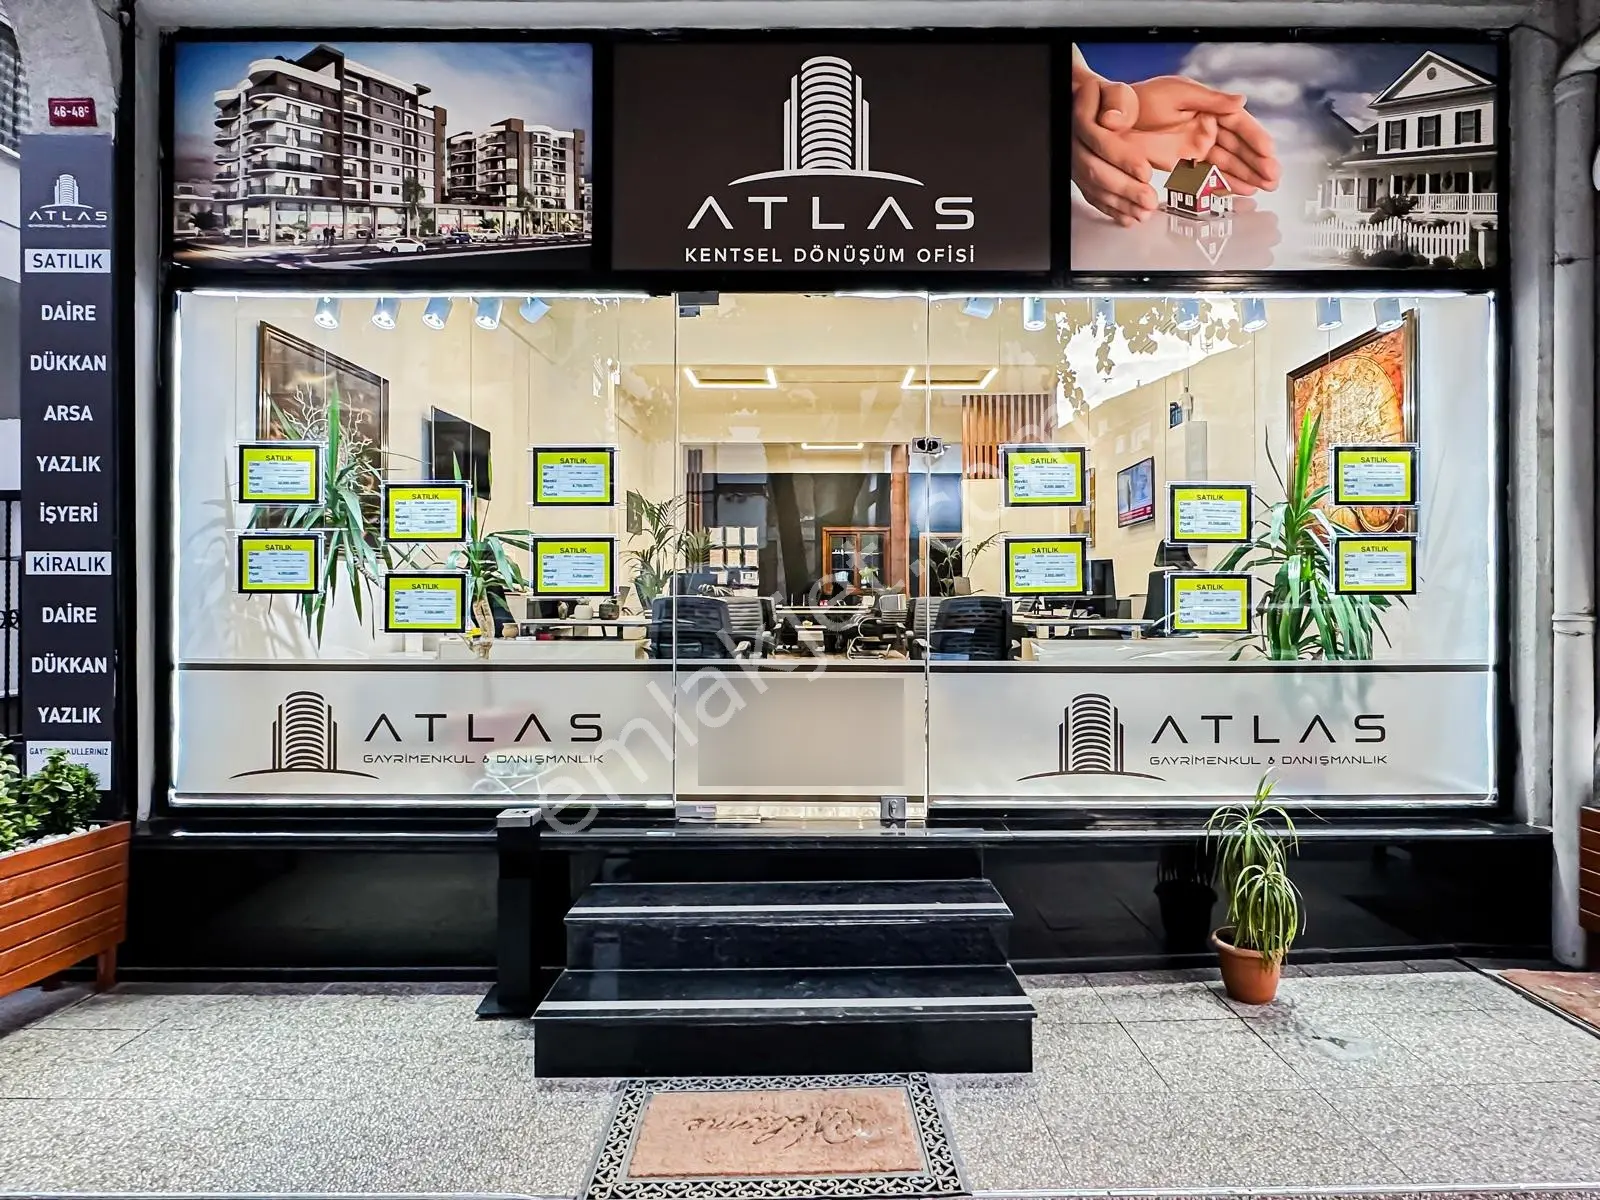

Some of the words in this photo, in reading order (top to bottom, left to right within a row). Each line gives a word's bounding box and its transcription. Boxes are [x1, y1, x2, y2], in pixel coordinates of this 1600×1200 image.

[28, 210, 108, 221] ATLAS
[687, 195, 975, 230] ATLAS
[33, 253, 103, 269] SATILIK
[685, 247, 783, 263] KENTSEL
[794, 244, 904, 266] DÖNÜŞÜM
[916, 244, 974, 264] OFİSİ
[41, 300, 97, 321] DAİRE
[30, 350, 107, 371] DÜKKAN
[43, 404, 94, 422] ARSA
[36, 455, 101, 472] YAZLIK
[40, 501, 98, 525] İŞYERİ
[33, 552, 106, 572] KİRALIK
[1196, 583, 1224, 591] SATILIK
[42, 602, 97, 623] DAİRE
[31, 652, 107, 674] DÜKKAN
[37, 706, 102, 724] YAZLIK
[364, 713, 603, 743] ATLAS
[1151, 714, 1386, 744] ATLAS
[363, 753, 476, 764] GAYRİMENKUL
[496, 754, 604, 766] DANIŞMANLIK
[1149, 754, 1262, 766] GAYRİMENKUL
[1281, 755, 1388, 767] DANIŞMANLIK
